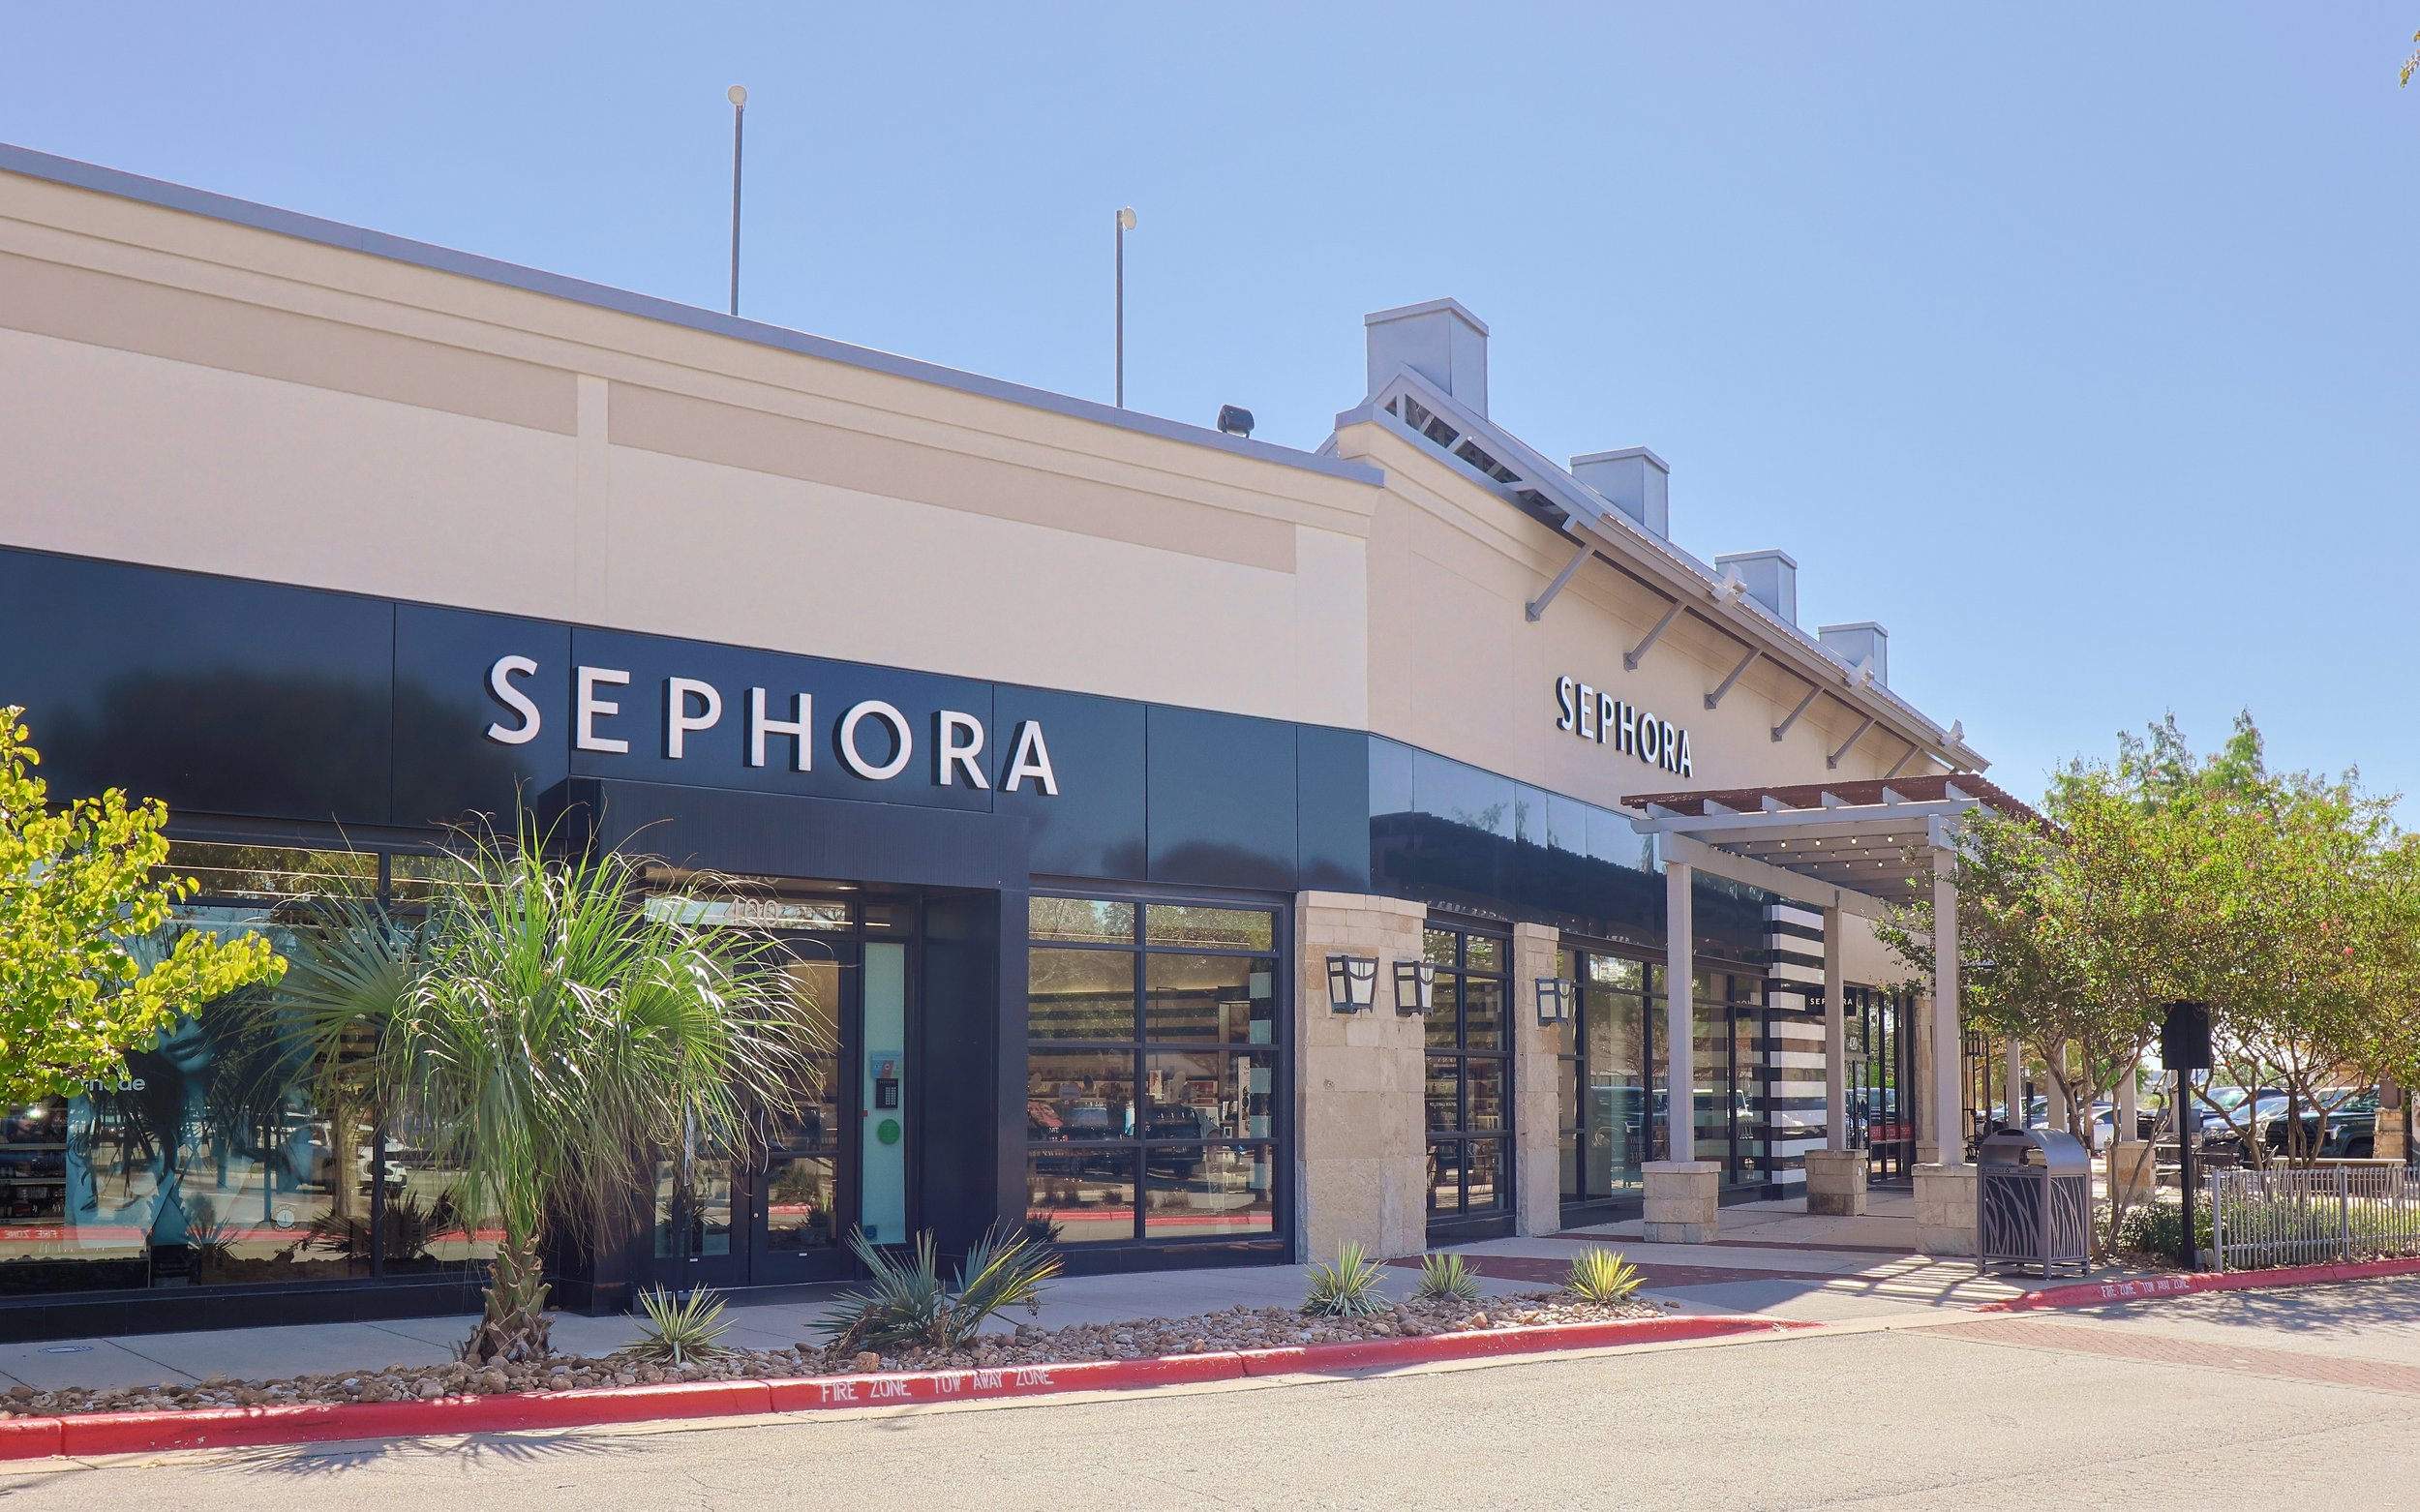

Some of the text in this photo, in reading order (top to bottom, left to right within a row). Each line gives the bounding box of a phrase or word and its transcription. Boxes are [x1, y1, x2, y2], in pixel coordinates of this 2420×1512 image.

[486, 654, 1059, 796] SEPHORA
[1556, 676, 1693, 778] SEPHORA
[723, 897, 778, 926] 400
[1809, 997, 1853, 1006] SEPRA
[78, 1074, 146, 1092] rhde
[2101, 1278, 2190, 1298] FIRE ZONE TOW AWAY ZONE
[821, 1367, 1054, 1403] FIRE ZONE TOW AWAY ZONE
